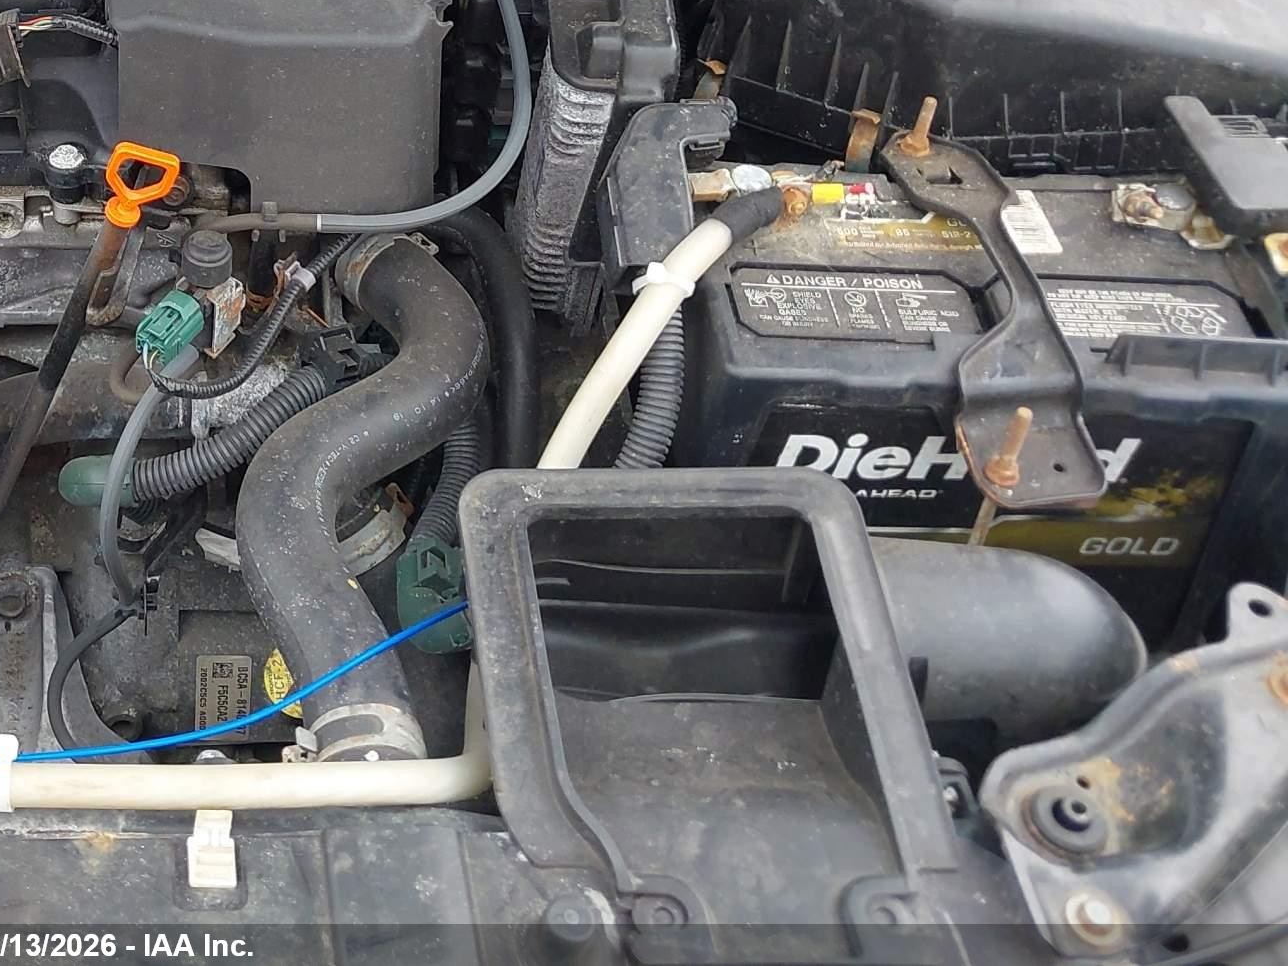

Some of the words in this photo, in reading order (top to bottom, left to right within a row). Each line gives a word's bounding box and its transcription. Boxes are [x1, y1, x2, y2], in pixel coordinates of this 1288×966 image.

[782, 274, 846, 287] DANGER
[863, 276, 924, 290] POISON
[792, 291, 822, 299] SHIELD
[794, 297, 816, 305] EYES
[777, 301, 822, 311] EXPLOSIVE
[778, 308, 808, 317] GASES
[898, 308, 938, 317] SULFURIC
[1078, 536, 1181, 557] GOLD
[273, 657, 286, 701] HCF-2
